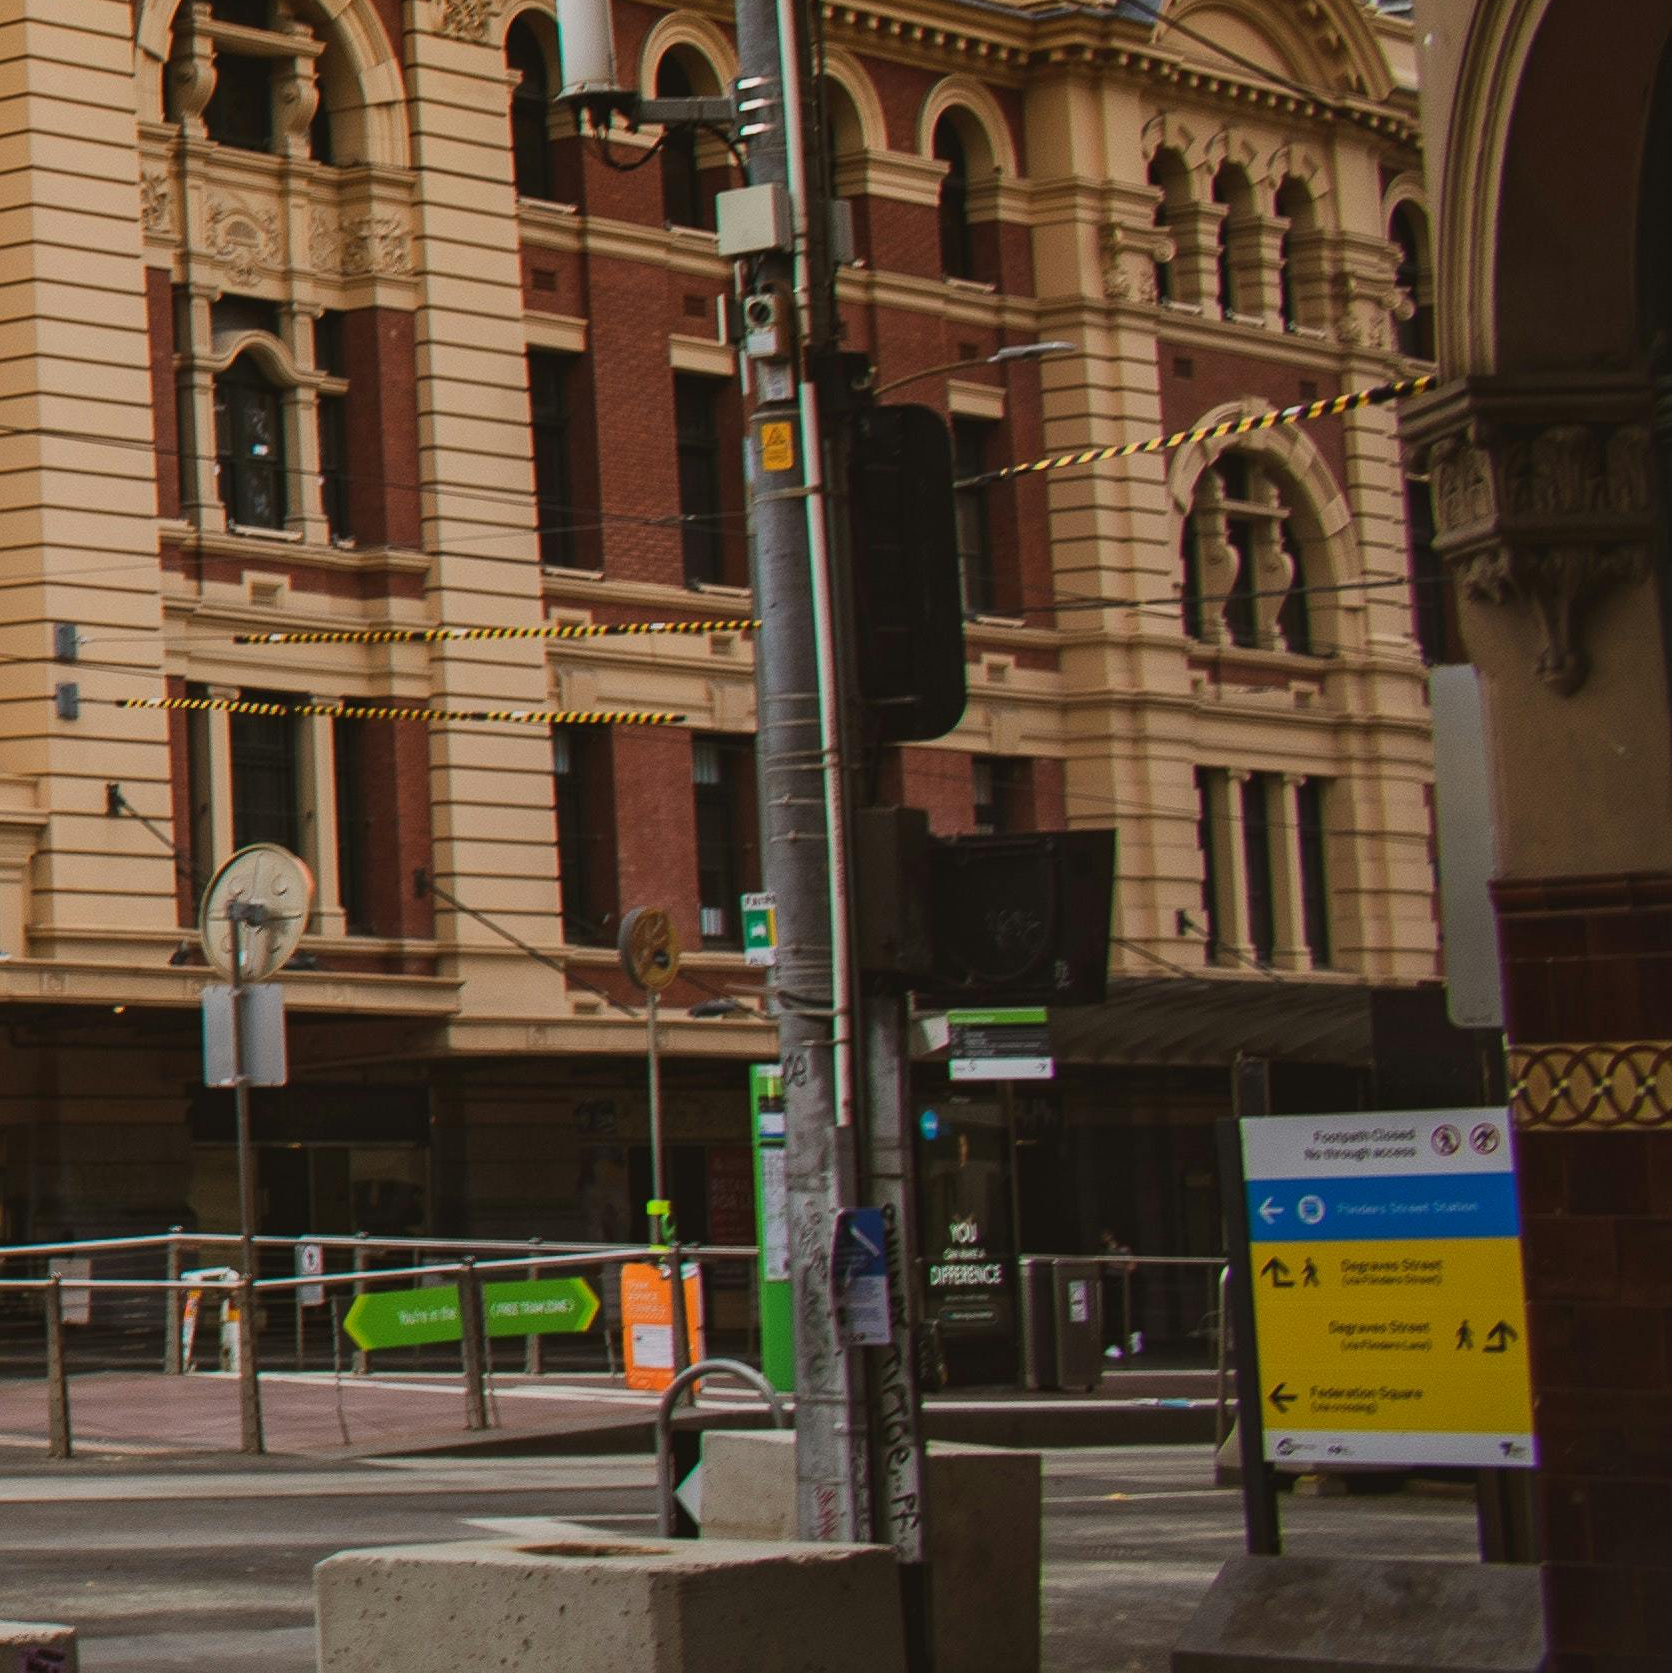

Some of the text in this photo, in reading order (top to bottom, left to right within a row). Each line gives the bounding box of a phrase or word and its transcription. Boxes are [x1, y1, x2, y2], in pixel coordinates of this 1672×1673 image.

[1312, 1128, 1416, 1145] Footpath Closed
[1304, 1146, 1417, 1163] No through access
[1337, 1200, 1478, 1215] Flinders Street Station
[949, 1222, 978, 1243] YOU
[1341, 1258, 1443, 1273] Degraves Street
[929, 1263, 1003, 1286] DIFFERENCE
[1329, 1320, 1430, 1336] Degraves Street
[1310, 1385, 1424, 1401] Federation Square
